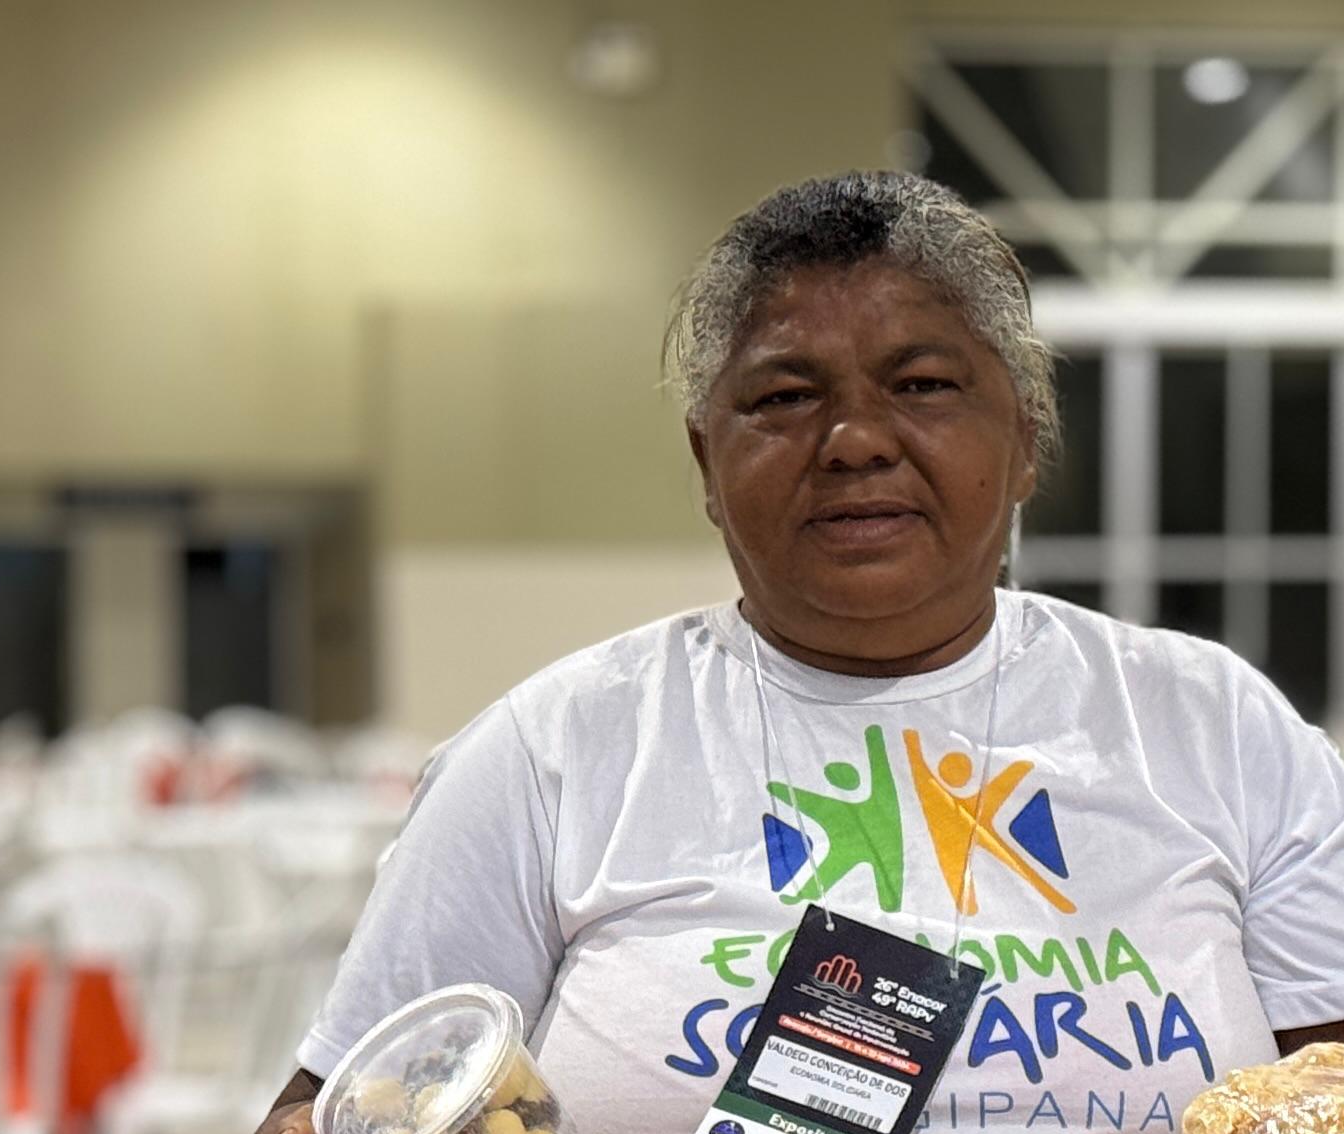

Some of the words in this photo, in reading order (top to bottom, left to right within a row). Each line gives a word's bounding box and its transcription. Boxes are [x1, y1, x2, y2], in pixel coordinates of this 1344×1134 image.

[700, 927, 1162, 998] ECOMIA
[897, 986, 948, 1013] Enacor
[665, 983, 1215, 1085] SOÁRIA
[767, 1039, 811, 1062] VALDECI
[868, 1077, 884, 1091] DE
[884, 1081, 909, 1098] DOS
[915, 1090, 1175, 1132] IPANA
